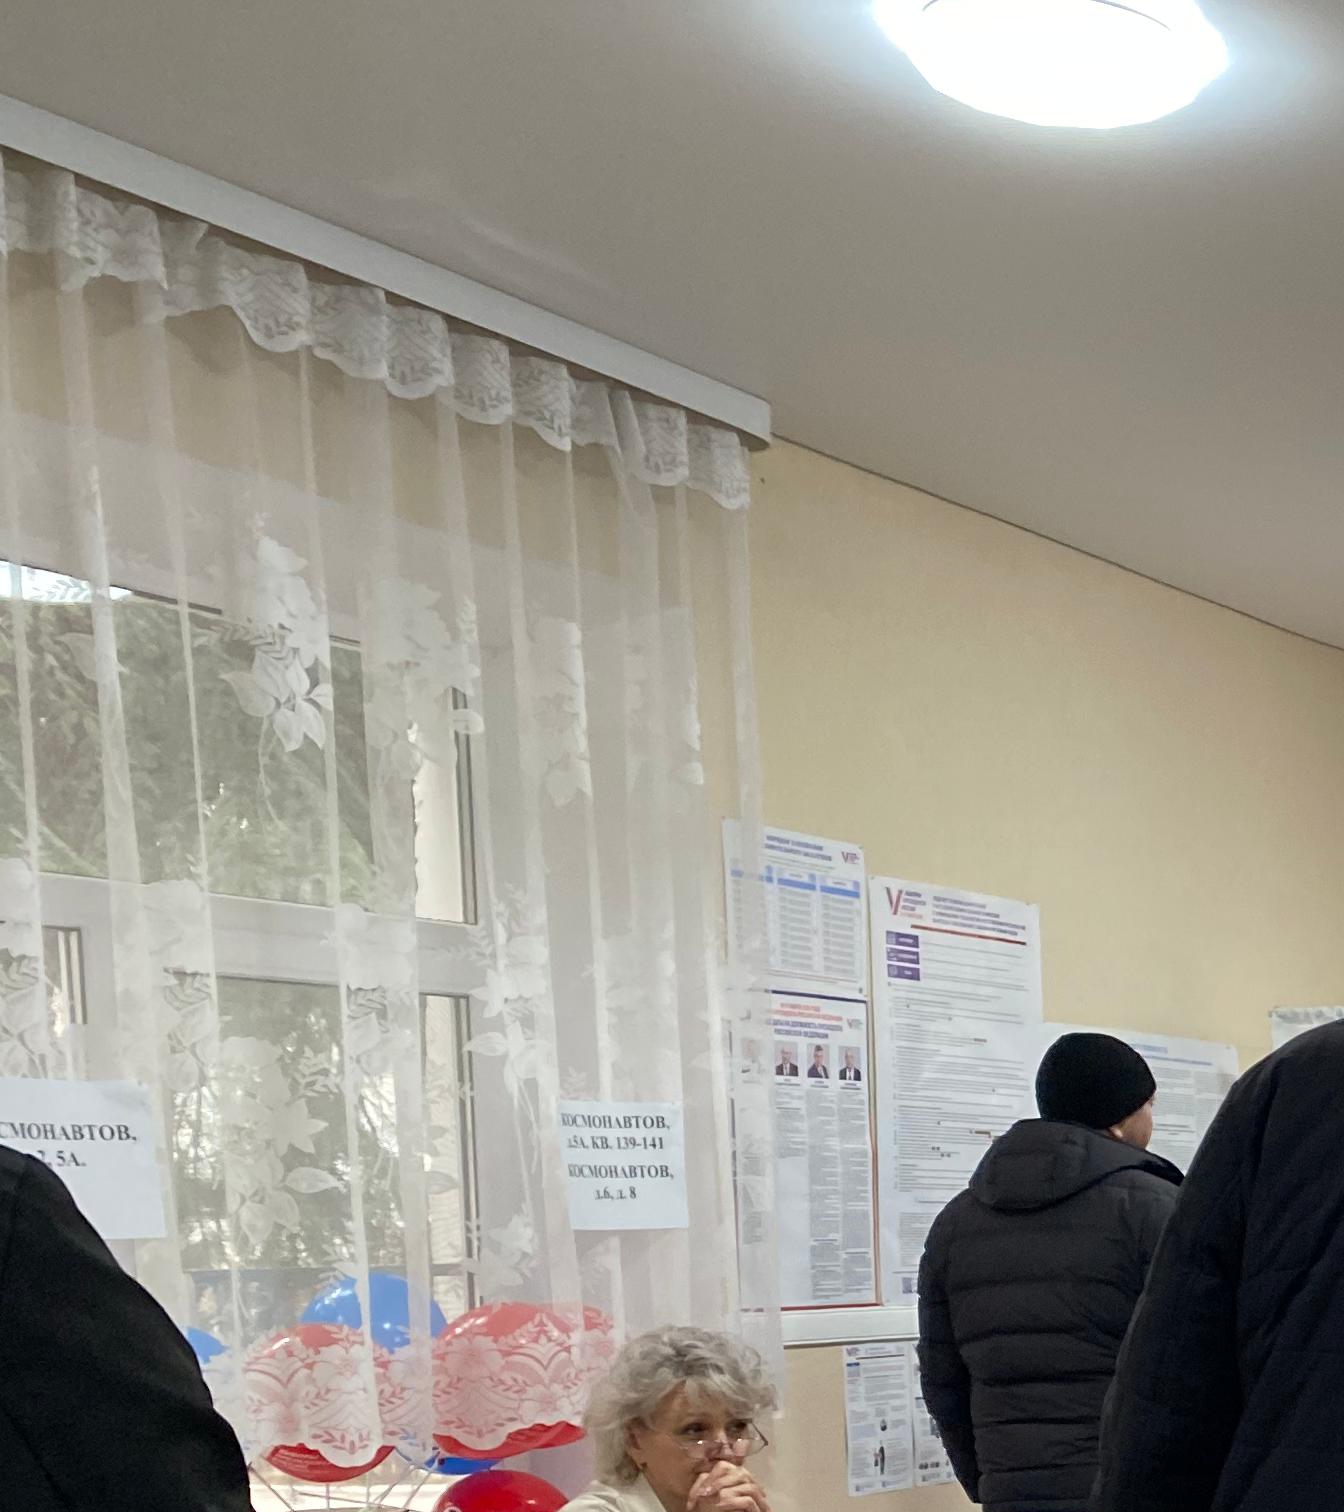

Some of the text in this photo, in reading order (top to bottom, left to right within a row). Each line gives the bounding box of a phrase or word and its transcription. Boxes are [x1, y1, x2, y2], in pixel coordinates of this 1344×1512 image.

[561, 1113, 670, 1130] КОСМОНАВТОВ,
[0, 1122, 137, 1141] СМОНАВТОВ,
[616, 1136, 664, 1150] 139-141
[568, 1164, 674, 1180] КОСМОНАВТОВ,
[629, 1186, 637, 1199] 8
